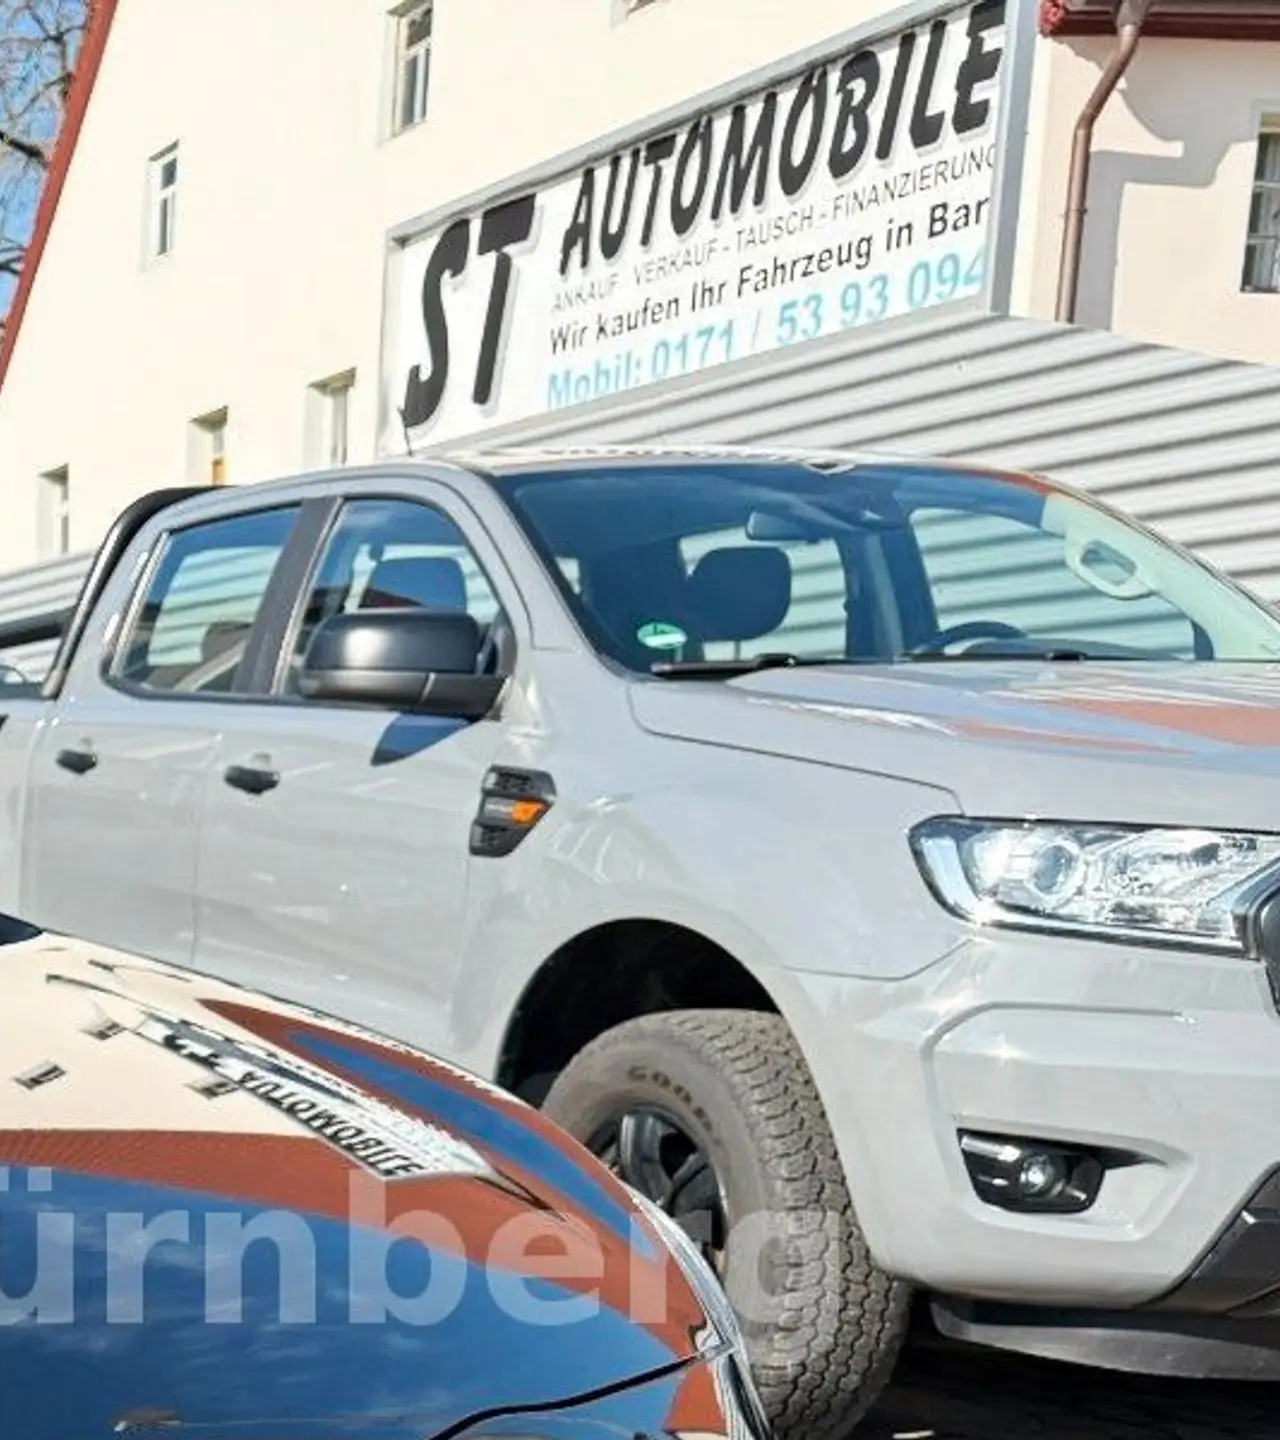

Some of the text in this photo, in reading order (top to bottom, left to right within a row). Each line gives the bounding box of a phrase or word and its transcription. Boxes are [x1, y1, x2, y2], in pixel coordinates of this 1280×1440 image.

[403, 0, 1006, 428] ST AUTOMOBILE
[550, 197, 990, 354] Wir kaufen Ihr Fahrzeug in Bar
[634, 237, 718, 285] VERKAUF
[737, 204, 815, 253] TAUSCH
[548, 351, 642, 410] Mobil:
[651, 318, 735, 379] 0171
[776, 292, 825, 344] 53
[839, 272, 890, 327] 93
